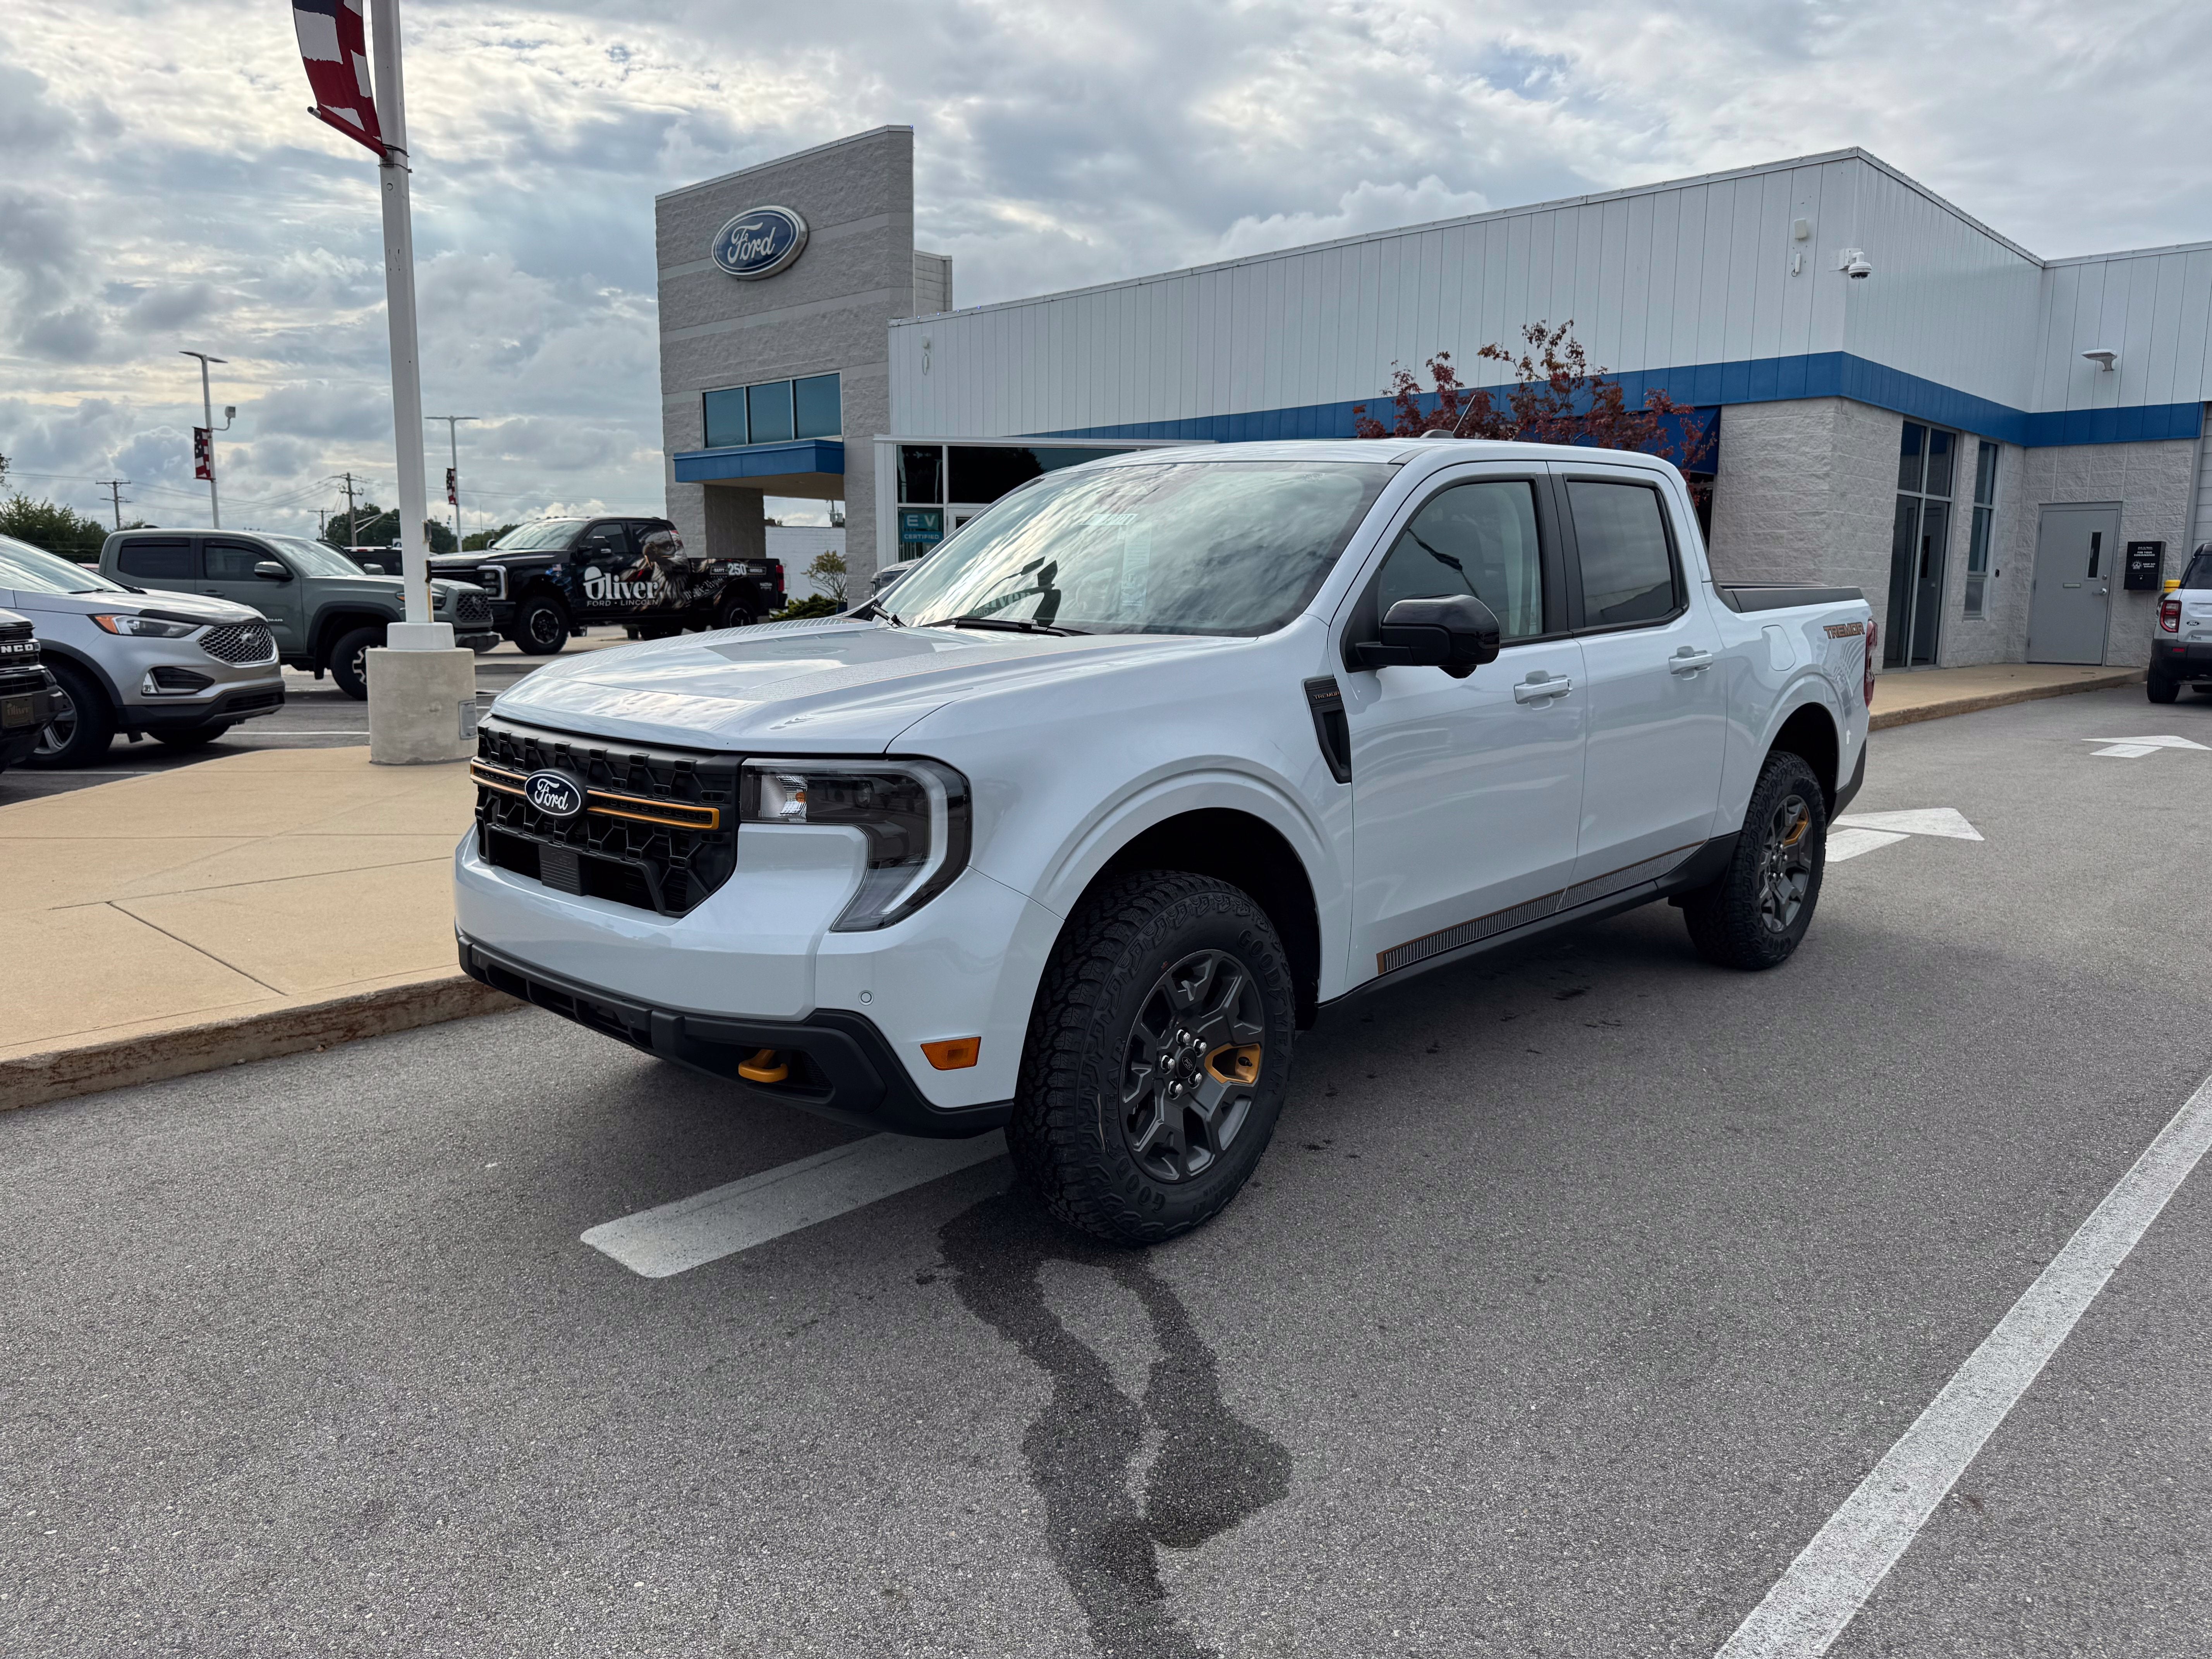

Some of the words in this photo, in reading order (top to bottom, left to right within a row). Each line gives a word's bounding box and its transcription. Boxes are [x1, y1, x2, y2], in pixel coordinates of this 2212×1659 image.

[727, 222, 776, 264] Ford
[907, 515, 936, 527] EV
[728, 563, 747, 575] 250
[583, 566, 658, 600] Oliver
[1822, 622, 1865, 639] TREMOR
[1313, 691, 1340, 699] TREMOR
[534, 778, 568, 810] Ford
